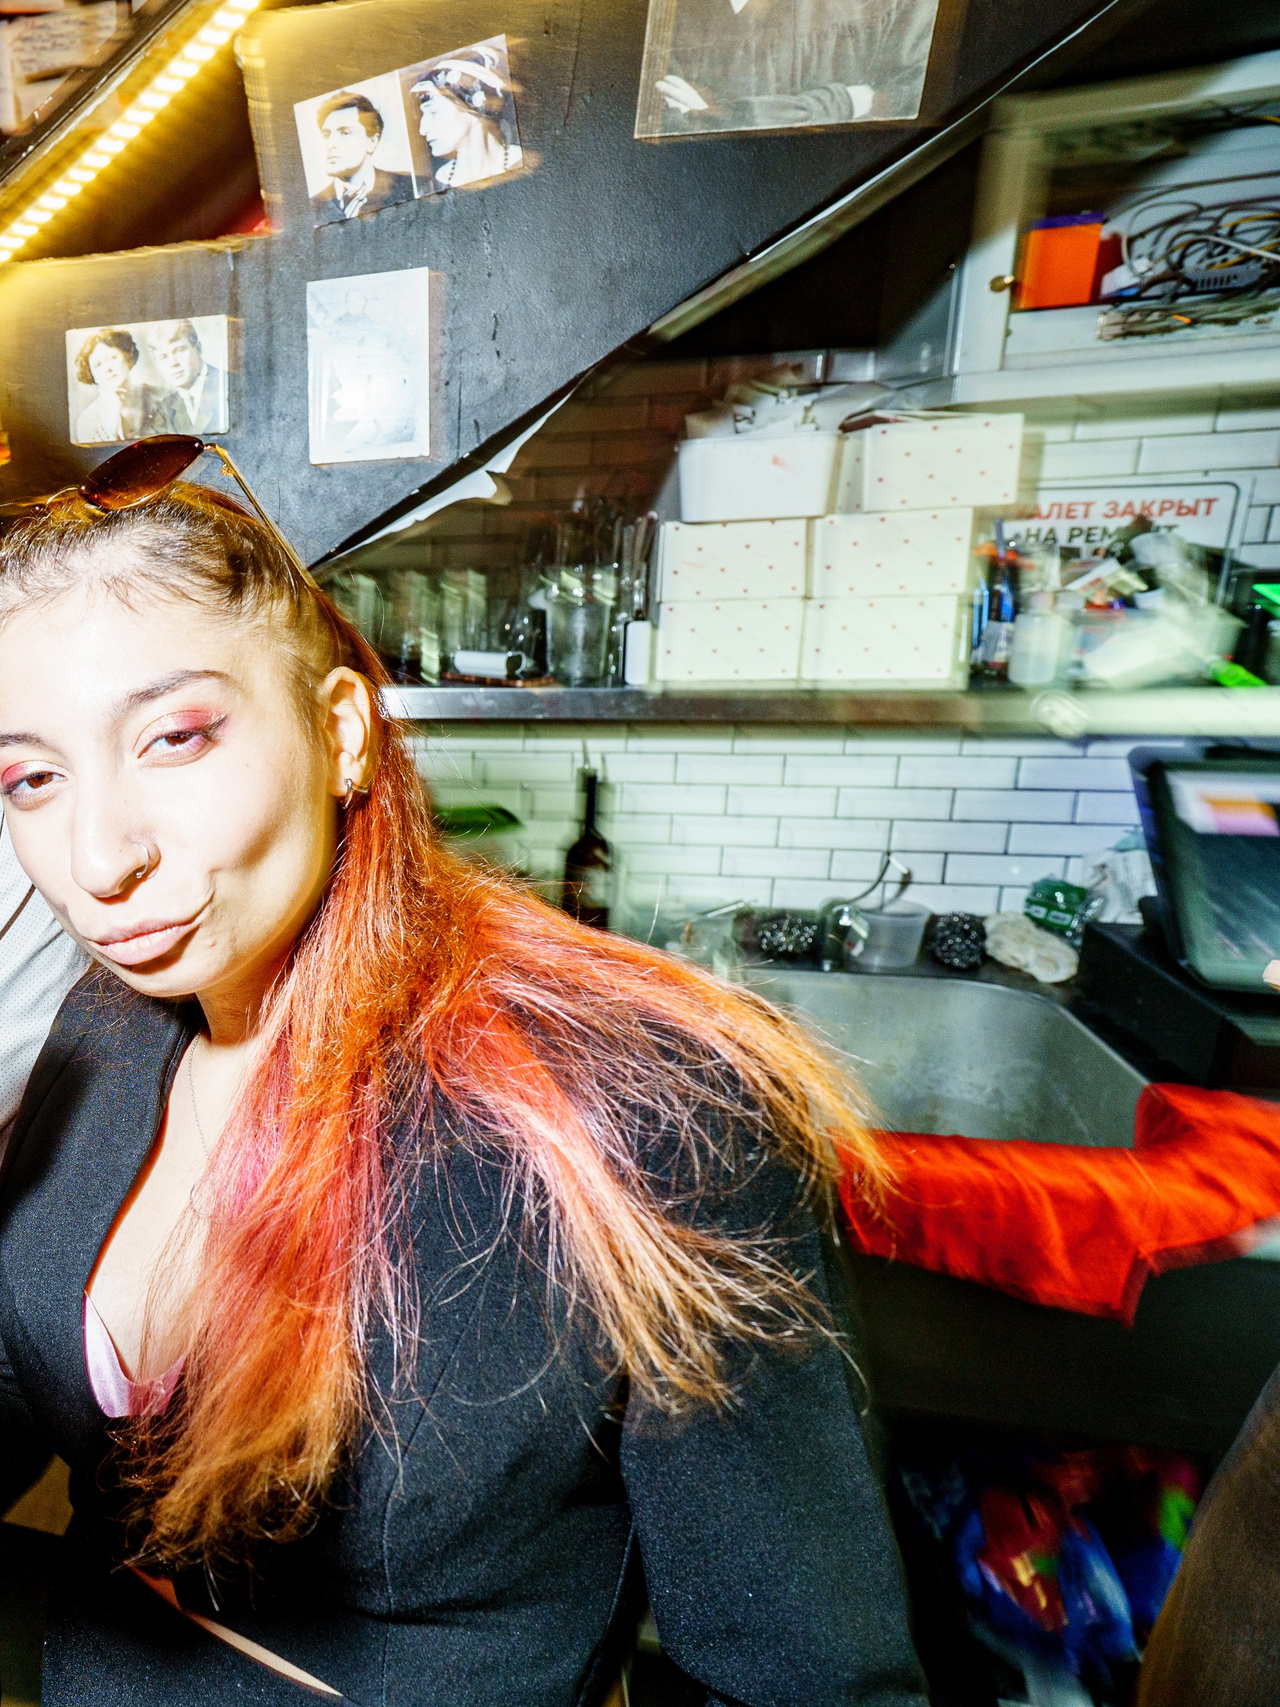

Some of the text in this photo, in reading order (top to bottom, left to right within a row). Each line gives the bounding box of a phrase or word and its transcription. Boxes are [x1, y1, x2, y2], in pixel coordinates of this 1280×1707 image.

[1021, 497, 1219, 520] АЛЕТ ЗАКРЫТ
[1024, 527, 1059, 544] НА
